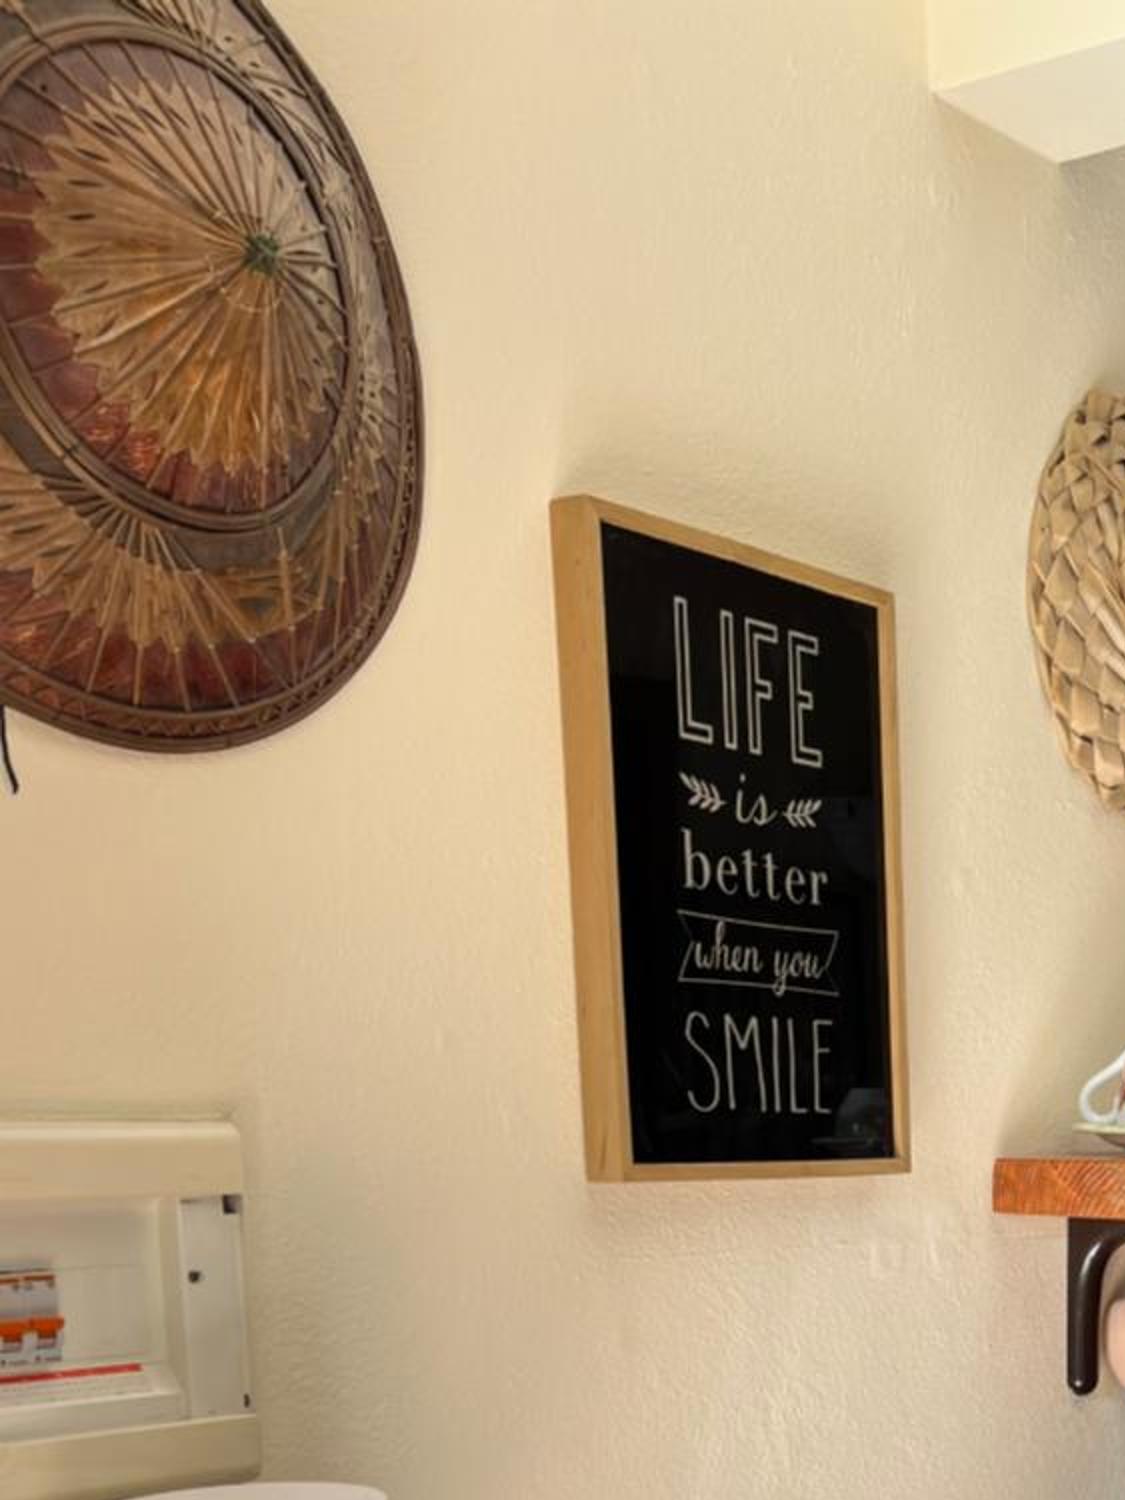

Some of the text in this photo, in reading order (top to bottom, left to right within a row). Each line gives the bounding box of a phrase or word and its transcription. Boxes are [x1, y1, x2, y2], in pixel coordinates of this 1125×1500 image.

[672, 594, 824, 769] LIFE
[734, 773, 777, 827] is
[682, 827, 829, 906] better
[693, 920, 824, 997] when you
[684, 1010, 833, 1115] SMILE
